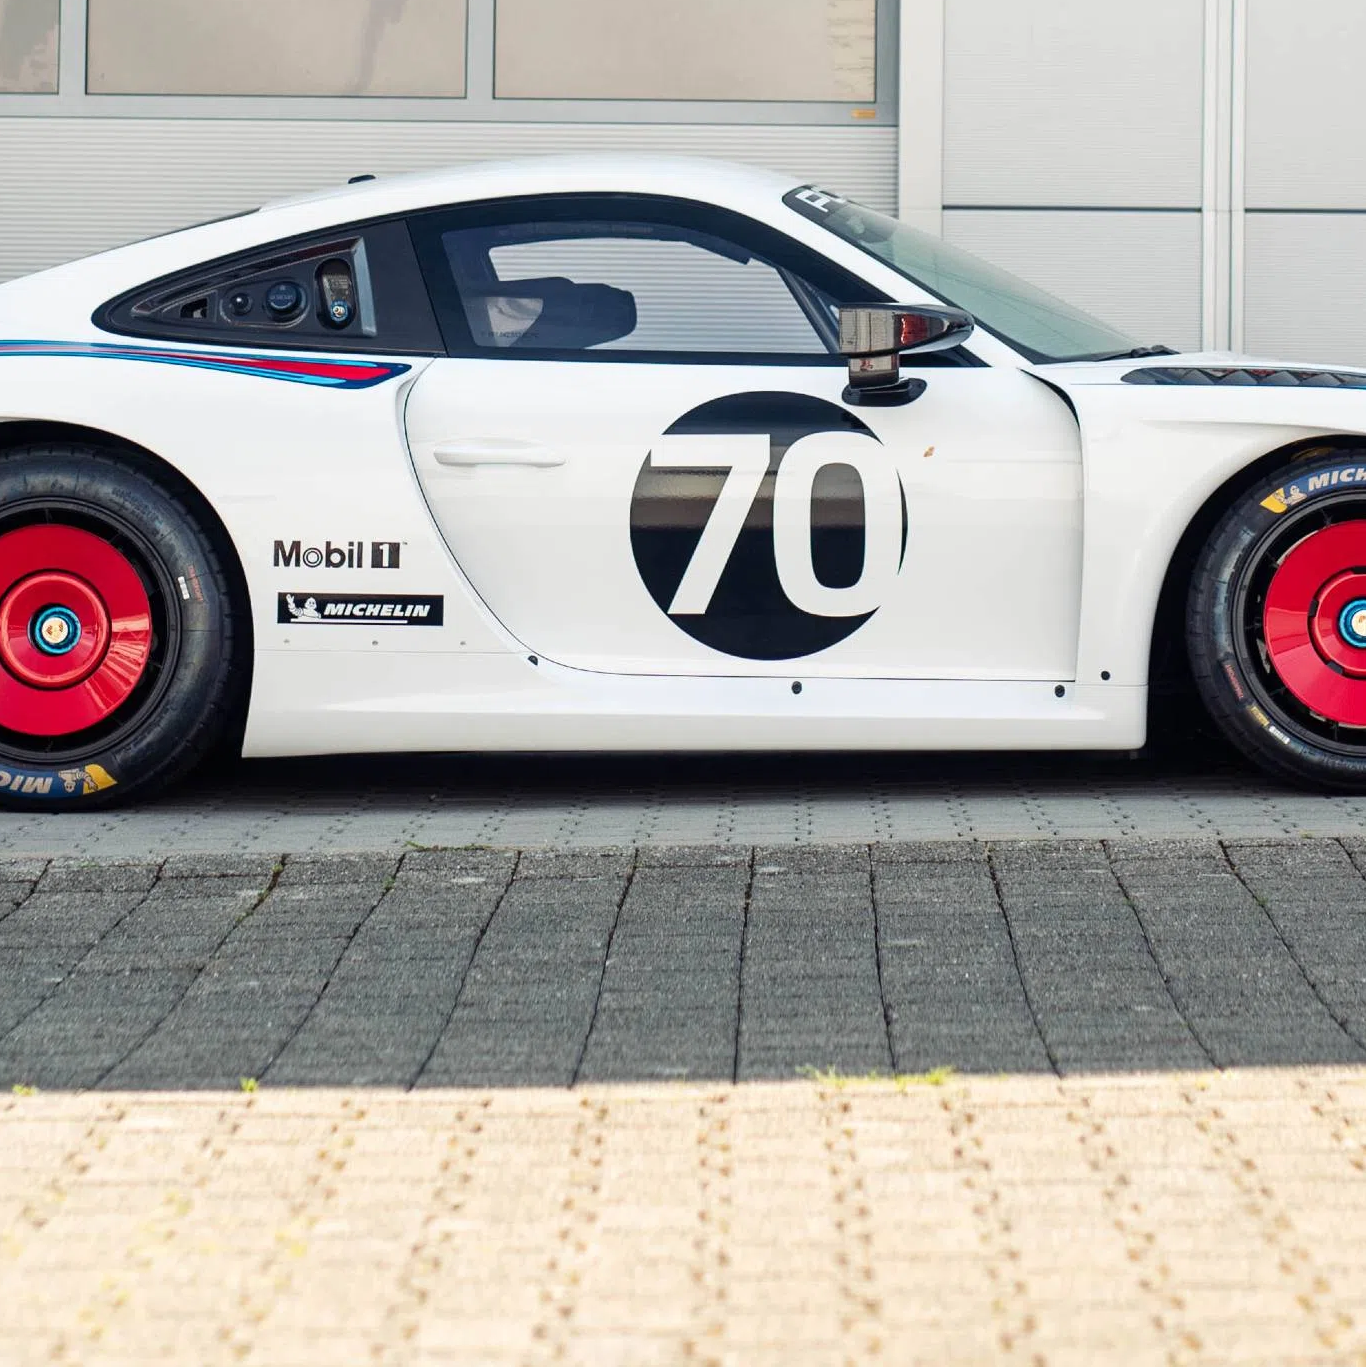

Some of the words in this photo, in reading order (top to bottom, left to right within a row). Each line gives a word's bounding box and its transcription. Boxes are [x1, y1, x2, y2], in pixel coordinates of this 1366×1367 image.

[650, 430, 902, 617] 70
[273, 540, 364, 569] Mobil
[323, 603, 431, 618] MICHELIN
